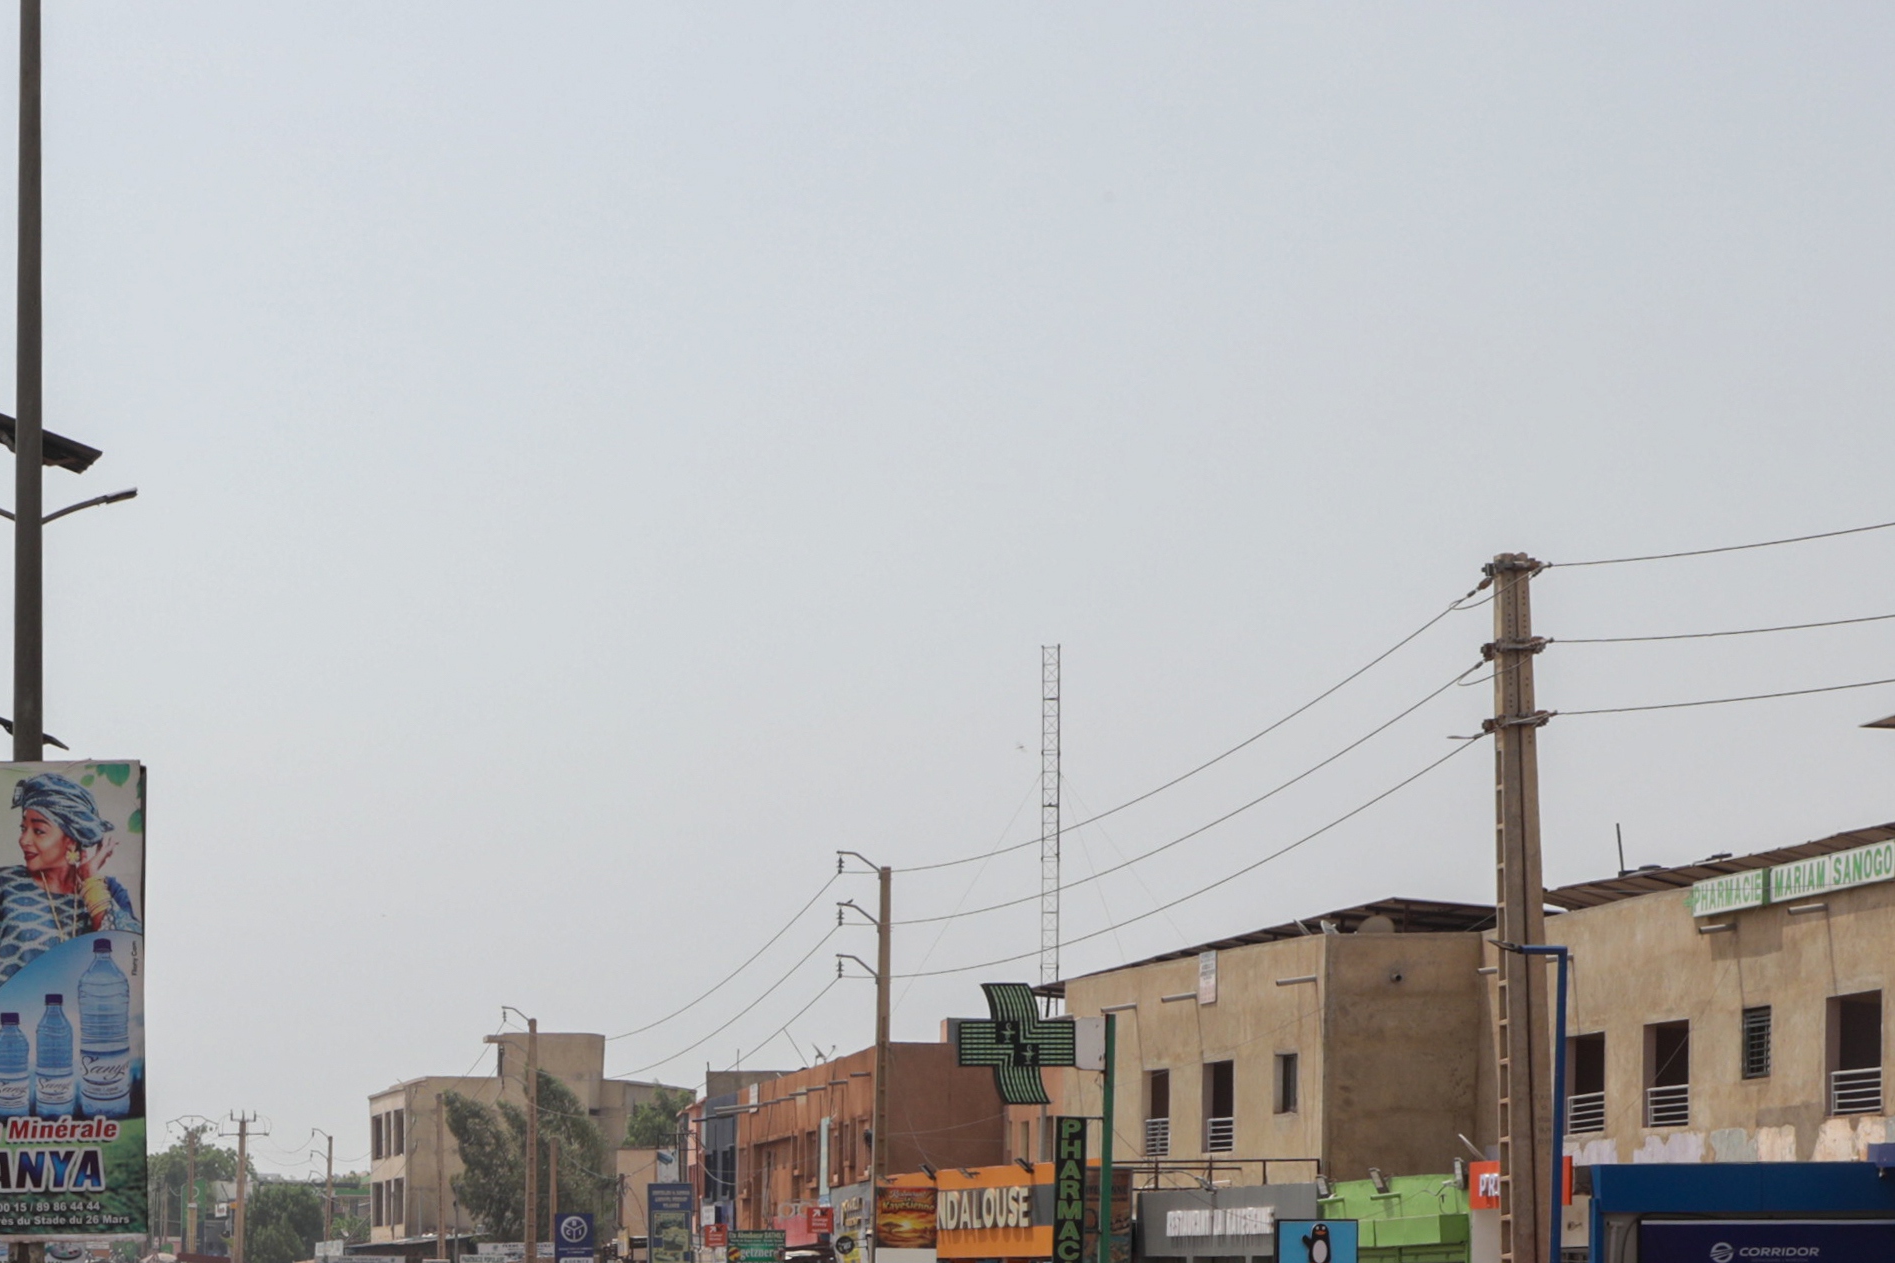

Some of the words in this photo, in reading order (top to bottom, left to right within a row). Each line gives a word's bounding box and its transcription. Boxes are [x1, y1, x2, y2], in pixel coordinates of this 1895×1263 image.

[1692, 873, 1762, 915] PHARMACIE
[1774, 860, 1826, 898] MARIAM
[1833, 844, 1892, 886] SANOGO
[8, 1117, 118, 1140] Minérale
[14, 1202, 27, 1212] 15
[36, 1202, 50, 1212] 89
[53, 1201, 67, 1212] 86
[69, 1201, 84, 1212] 44
[86, 1201, 100, 1211] 44
[937, 1186, 1030, 1230] NDALOUSE
[17, 1216, 31, 1225] du
[34, 1215, 66, 1225] Stade
[69, 1215, 83, 1225] du
[85, 1215, 100, 1225] 26
[102, 1214, 130, 1225] Mars
[1739, 1247, 1820, 1257] CORRIDOR
